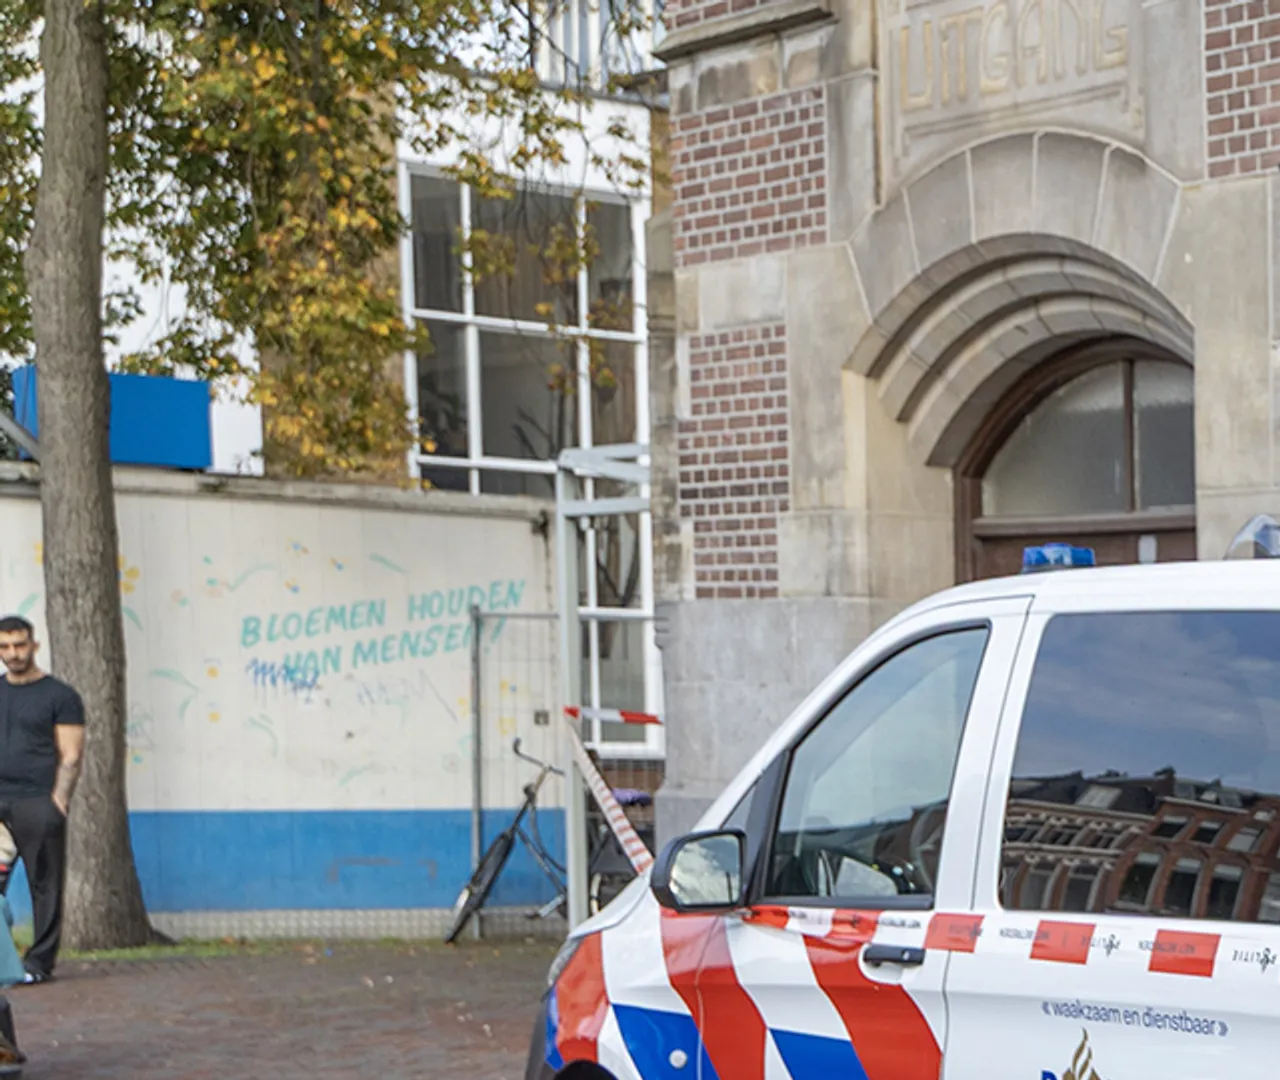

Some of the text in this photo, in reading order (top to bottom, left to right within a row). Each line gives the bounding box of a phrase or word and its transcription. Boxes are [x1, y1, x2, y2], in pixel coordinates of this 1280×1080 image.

[240, 579, 526, 649] BLOEMEN HOUDEN
[1123, 1008, 1141, 1027] en
